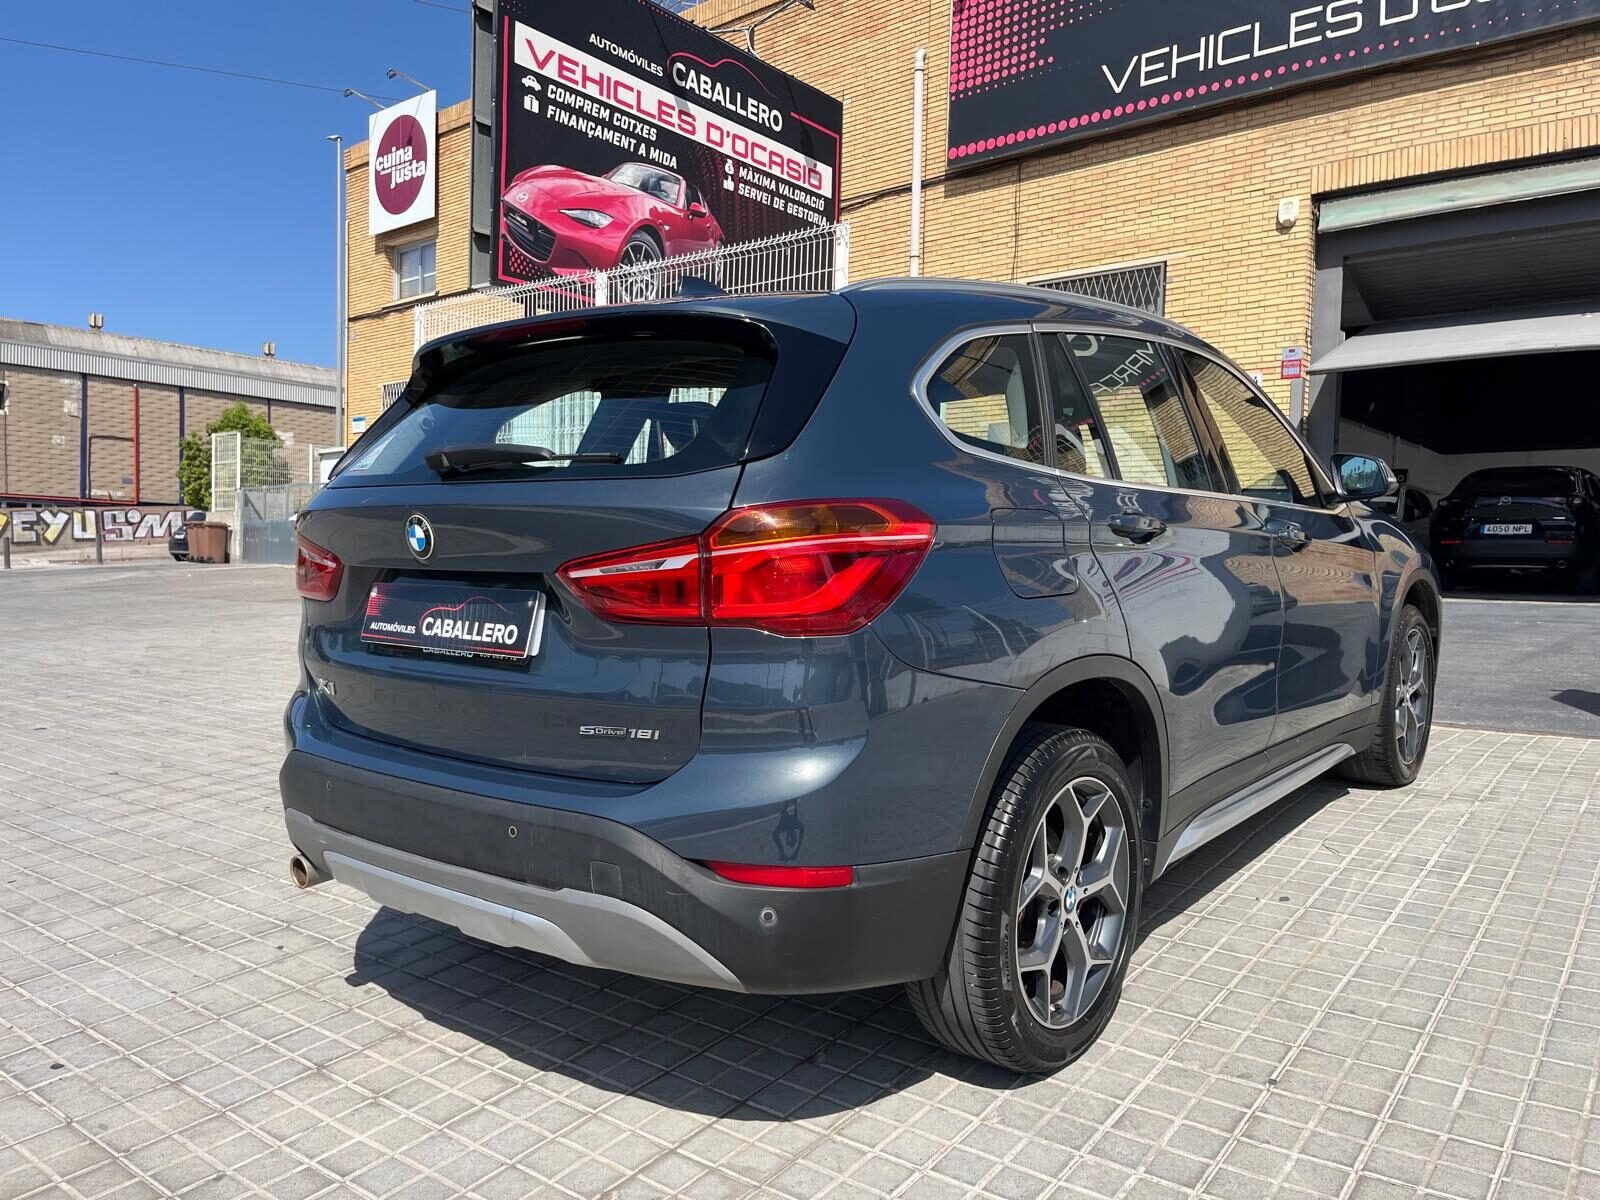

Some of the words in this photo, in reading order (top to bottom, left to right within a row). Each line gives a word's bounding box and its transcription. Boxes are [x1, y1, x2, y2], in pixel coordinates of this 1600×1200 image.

[1102, 0, 1362, 94] VEHICLES
[589, 33, 663, 77] AUTOMÓVILES
[672, 62, 783, 132] CABALLERO
[525, 38, 697, 137] VEHICLES
[706, 121, 822, 191] D'OCASIÓ
[547, 84, 610, 122] COMPREM
[613, 112, 657, 141] COTXES
[375, 145, 413, 172] cuina
[547, 105, 636, 152] FINANÇAMENT
[638, 143, 646, 157] A
[649, 146, 677, 169] MIDA
[390, 159, 426, 190] justa
[739, 165, 776, 191] MÀXIMA
[779, 182, 825, 211] VALORACIÓ
[738, 183, 771, 206] SERVEI
[774, 199, 784, 211] DE
[787, 203, 827, 227] GESTORIA
[1486, 525, 1510, 533] 4050
[1513, 525, 1530, 533] NPL
[370, 621, 416, 634] AUTOMÓVILES
[422, 616, 518, 645] CABALLERO
